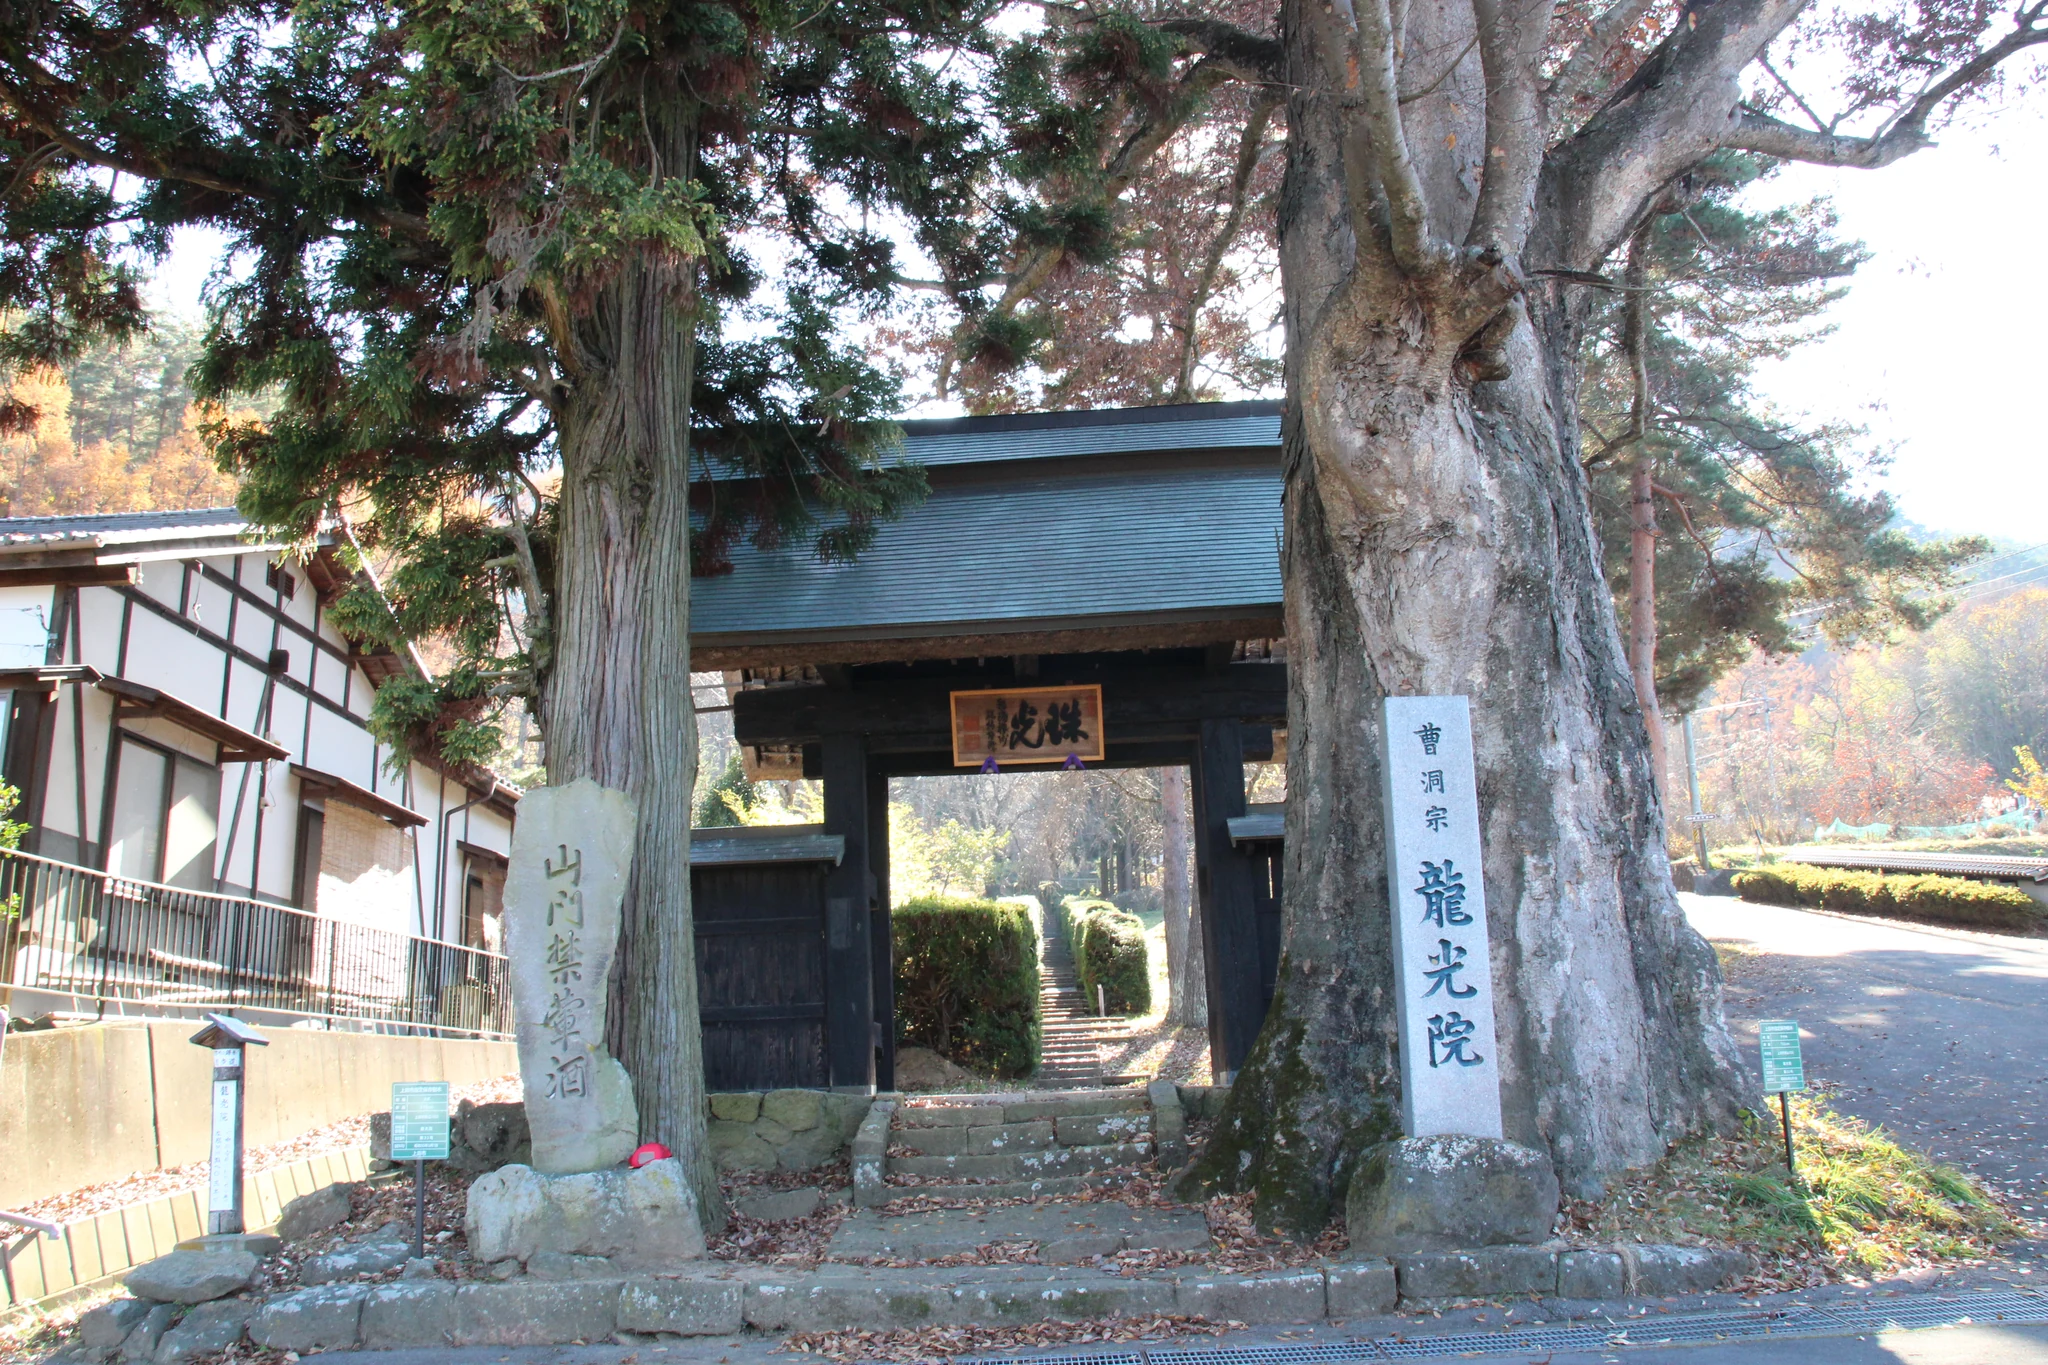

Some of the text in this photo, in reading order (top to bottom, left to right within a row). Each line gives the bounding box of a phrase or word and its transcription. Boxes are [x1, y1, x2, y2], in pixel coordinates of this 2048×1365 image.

[1413, 722, 1449, 833] 曹洞宗
[544, 843, 587, 1100] 山門禁葷酒
[1413, 859, 1484, 1069] 龍光院
